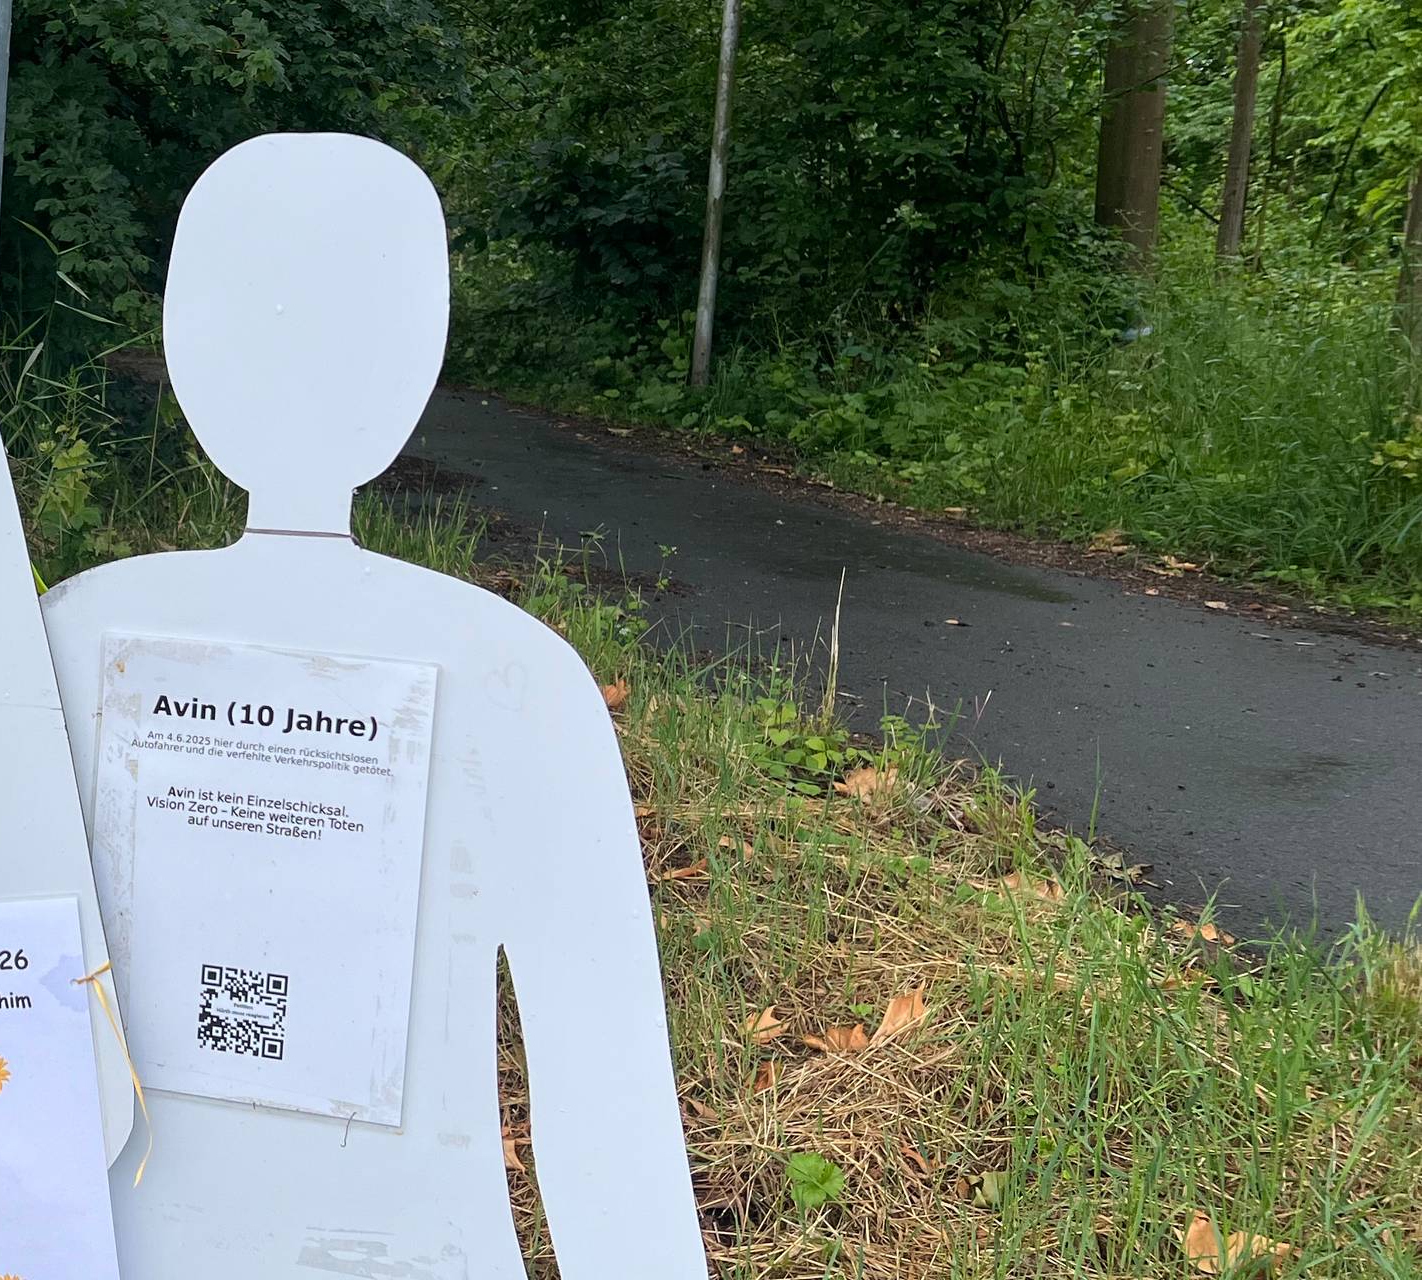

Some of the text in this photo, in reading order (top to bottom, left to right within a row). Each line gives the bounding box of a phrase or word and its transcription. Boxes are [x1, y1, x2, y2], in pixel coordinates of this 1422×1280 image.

[153, 695, 378, 741] Avin (10 Jahre)
[131, 738, 394, 777] Autofahrer und die verfehlte Verkehrspolitik getötet.
[147, 730, 379, 765] Am 4.6.2025 hier durch einen rücksichtslosen
[147, 796, 185, 811] Vision
[188, 801, 218, 815] Zero
[231, 805, 265, 821] Keine
[269, 812, 325, 828] weiteren
[328, 817, 364, 833] Toten
[168, 786, 349, 818] Avin ist kein Einzelschicksal.
[187, 815, 322, 841] auf unseren Straßen!
